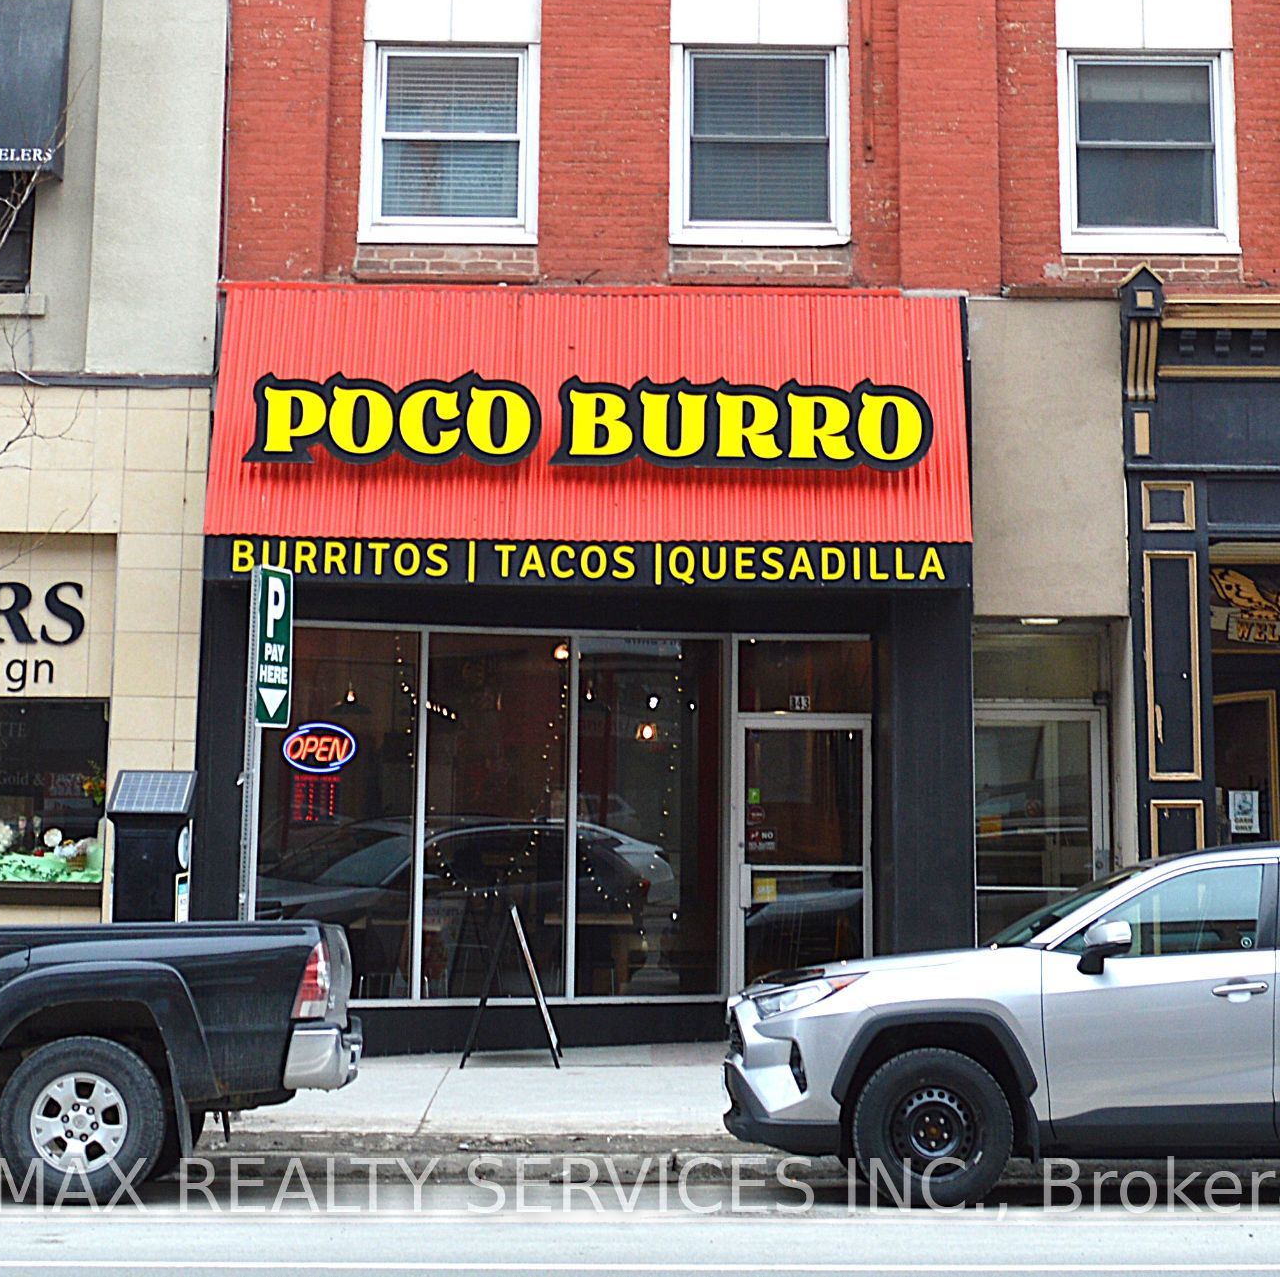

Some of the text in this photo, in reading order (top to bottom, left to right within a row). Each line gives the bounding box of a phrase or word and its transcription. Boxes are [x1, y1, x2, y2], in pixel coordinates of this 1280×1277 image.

[261, 383, 926, 465] POCO BURRO
[231, 539, 946, 586] BURRITOS TACOS QUESADILLA
[266, 576, 286, 638] P
[264, 642, 285, 663] PAY
[258, 664, 289, 685] HERE
[286, 735, 351, 762] OPEN
